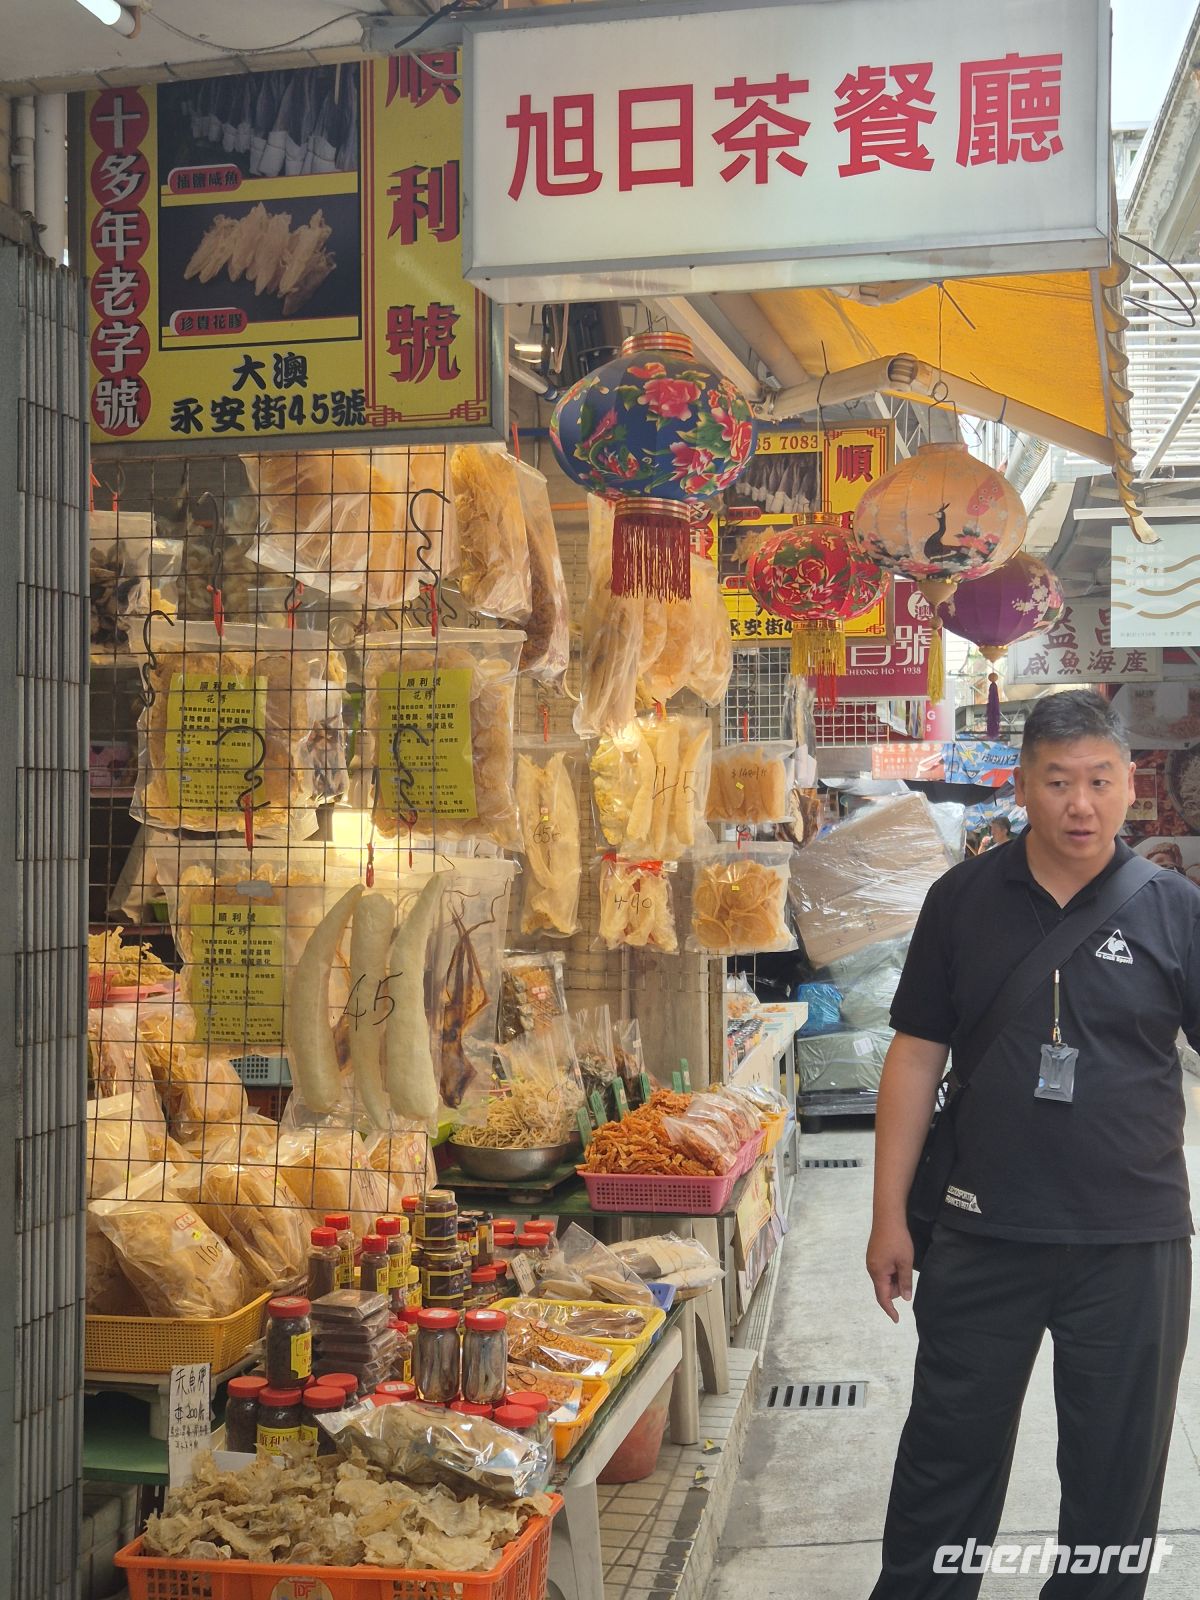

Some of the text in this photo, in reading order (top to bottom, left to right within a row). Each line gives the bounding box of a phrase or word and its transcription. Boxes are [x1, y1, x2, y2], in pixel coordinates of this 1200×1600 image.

[505, 52, 1064, 202] 旭日茶餐廳
[96, 96, 141, 430] 十多年老字號
[232, 352, 308, 392] 大澳
[780, 435, 818, 450] 7083
[903, 666, 921, 675] 1938
[342, 971, 403, 1032] 45
[259, 1432, 292, 1447] 順利
